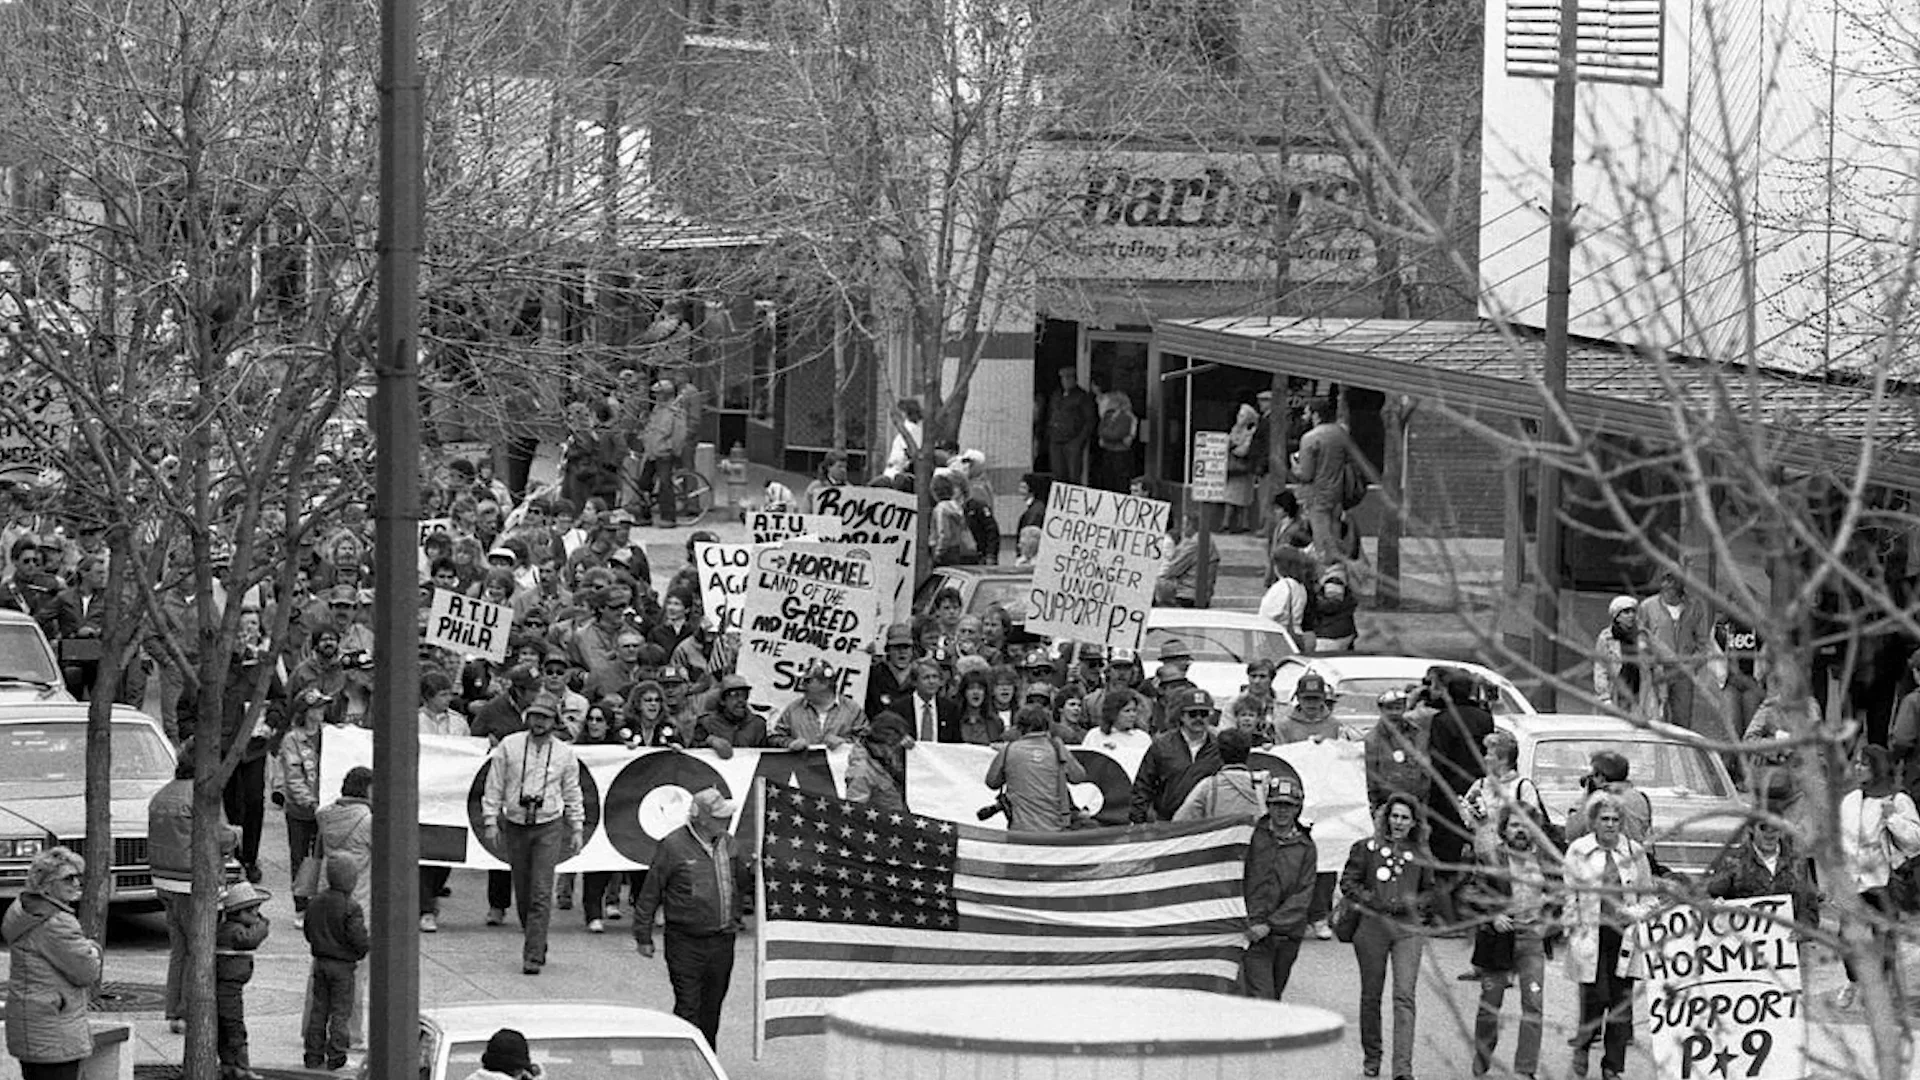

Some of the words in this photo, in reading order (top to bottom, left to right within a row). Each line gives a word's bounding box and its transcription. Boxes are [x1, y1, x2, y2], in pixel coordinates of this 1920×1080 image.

[817, 488, 918, 531] BOYCOTT
[1053, 485, 1103, 517] NEW
[1113, 495, 1165, 532] YORK
[1047, 516, 1164, 560] CARPENTERS
[1072, 545, 1100, 562] FOR
[1112, 555, 1125, 566] A
[787, 552, 869, 586] HORMEL
[1054, 555, 1142, 589] STRONGER
[759, 572, 798, 595] LAND
[802, 583, 823, 600] OF
[823, 588, 848, 606] THE
[1061, 576, 1117, 603] UNION
[449, 596, 499, 628] A.T.U.
[782, 597, 859, 633] GREED
[1028, 589, 1108, 627] SUPPORT
[751, 639, 787, 657] THE
[782, 622, 833, 650] HOME
[834, 636, 861, 654] OF
[1646, 901, 1787, 942] BOYCOTT
[1645, 938, 1797, 980] HORMEL
[1651, 989, 1802, 1034] SUPPORT
